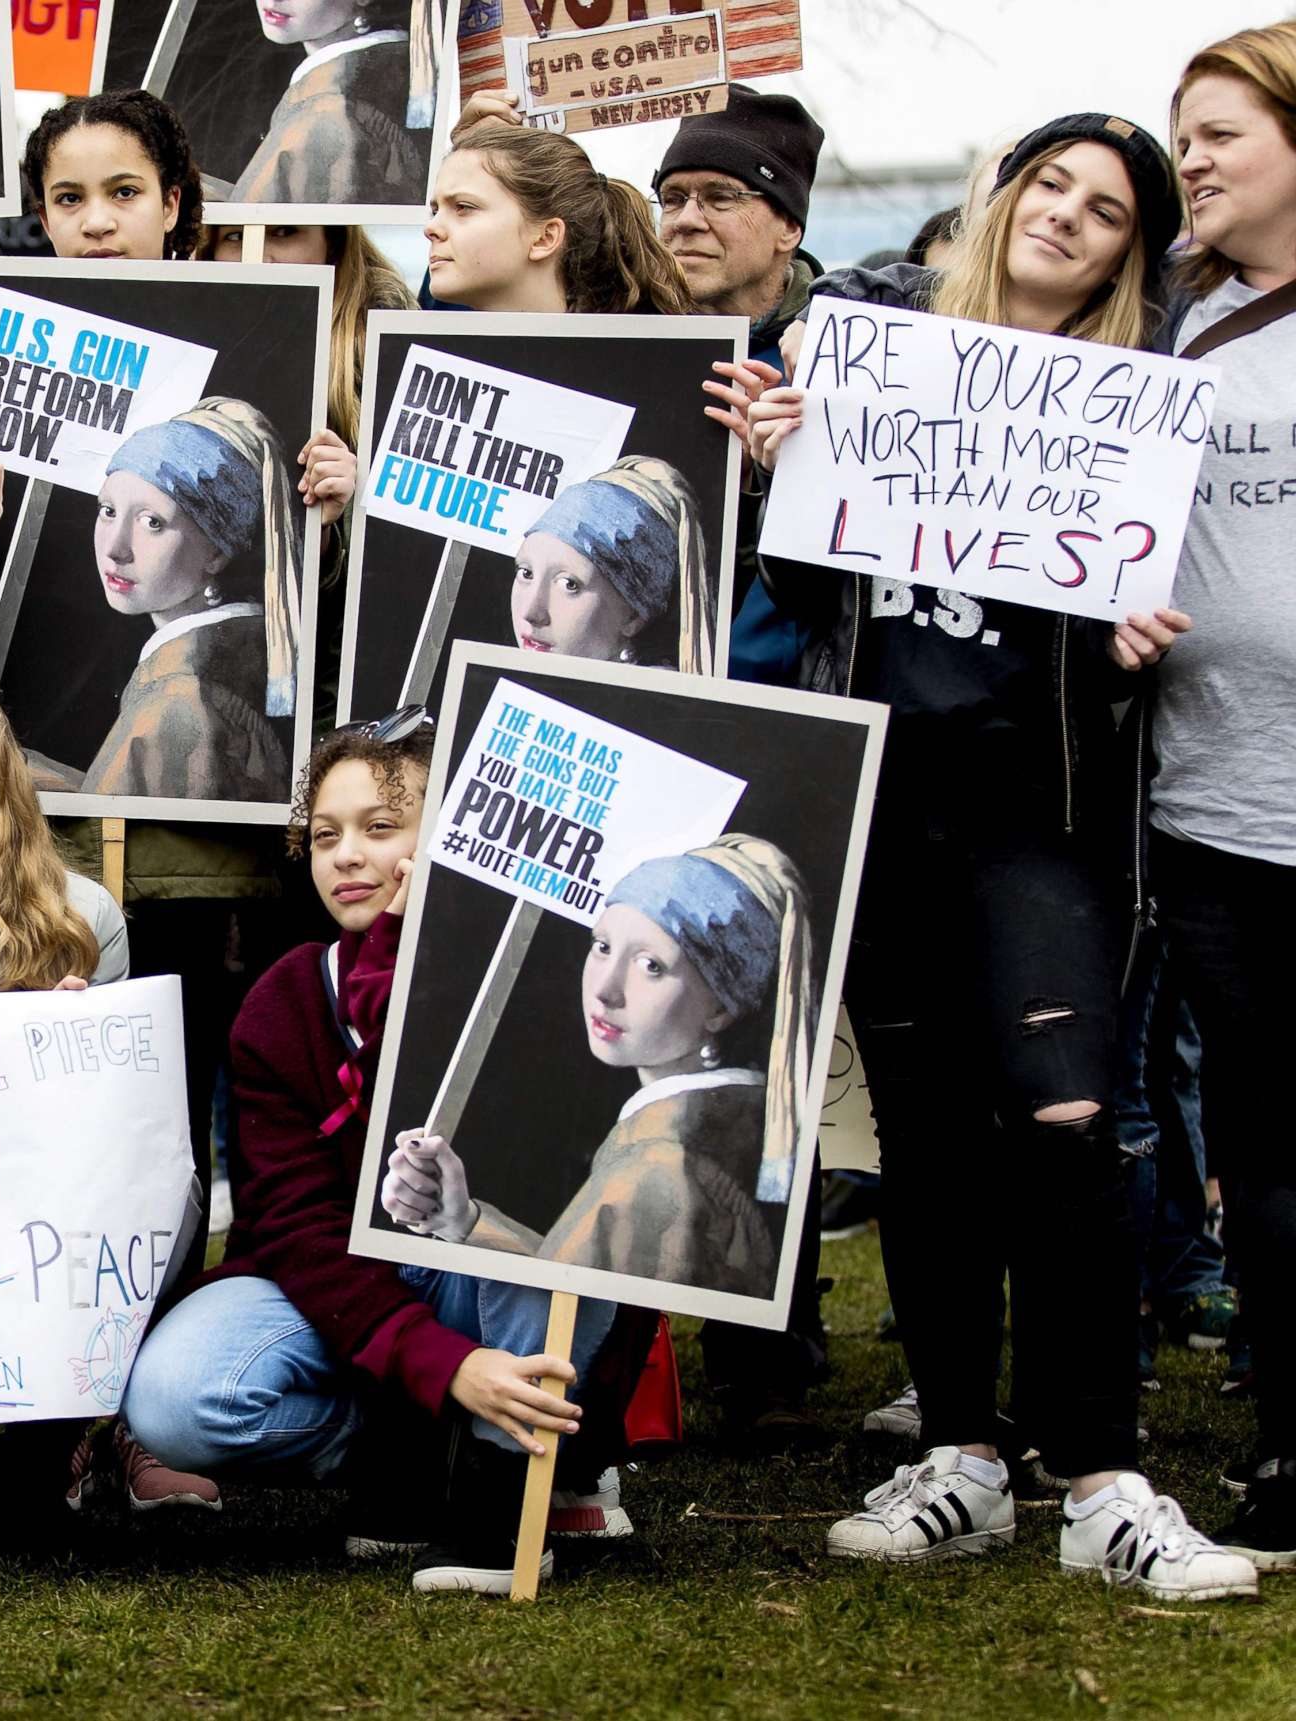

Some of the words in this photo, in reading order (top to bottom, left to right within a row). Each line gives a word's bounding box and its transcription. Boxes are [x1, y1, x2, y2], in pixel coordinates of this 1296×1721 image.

[526, 53, 584, 97] gun
[591, 14, 719, 72] control
[591, 102, 634, 127] NEW
[636, 90, 712, 122] JERSEY
[69, 329, 150, 391] GUN
[403, 363, 510, 432] DON'T
[805, 312, 914, 394] ARE
[951, 328, 1082, 418] YOUR
[1083, 361, 1215, 444] GUNS
[388, 408, 462, 471] KILL
[466, 431, 564, 500] THEIR
[824, 397, 985, 473] WORTH
[1003, 425, 1130, 483] MORE
[374, 454, 510, 536] FUTURE.
[873, 472, 1012, 512] THAN
[1027, 484, 1102, 524] OUR
[827, 497, 1157, 604] LIVES?
[486, 727, 525, 763] THE
[523, 745, 578, 785] GUNS
[577, 772, 620, 802] BUT
[497, 702, 536, 738] THE
[533, 719, 578, 756] NRA
[579, 738, 623, 775] HAS
[452, 777, 605, 887] POWER.
[475, 753, 518, 789] YOU
[516, 772, 573, 814] HAVE
[571, 795, 613, 831] THE
[441, 829, 605, 915] #VOTETHEMOUT
[23, 1013, 160, 1082] PIECE
[19, 1220, 173, 1311] PEACE
